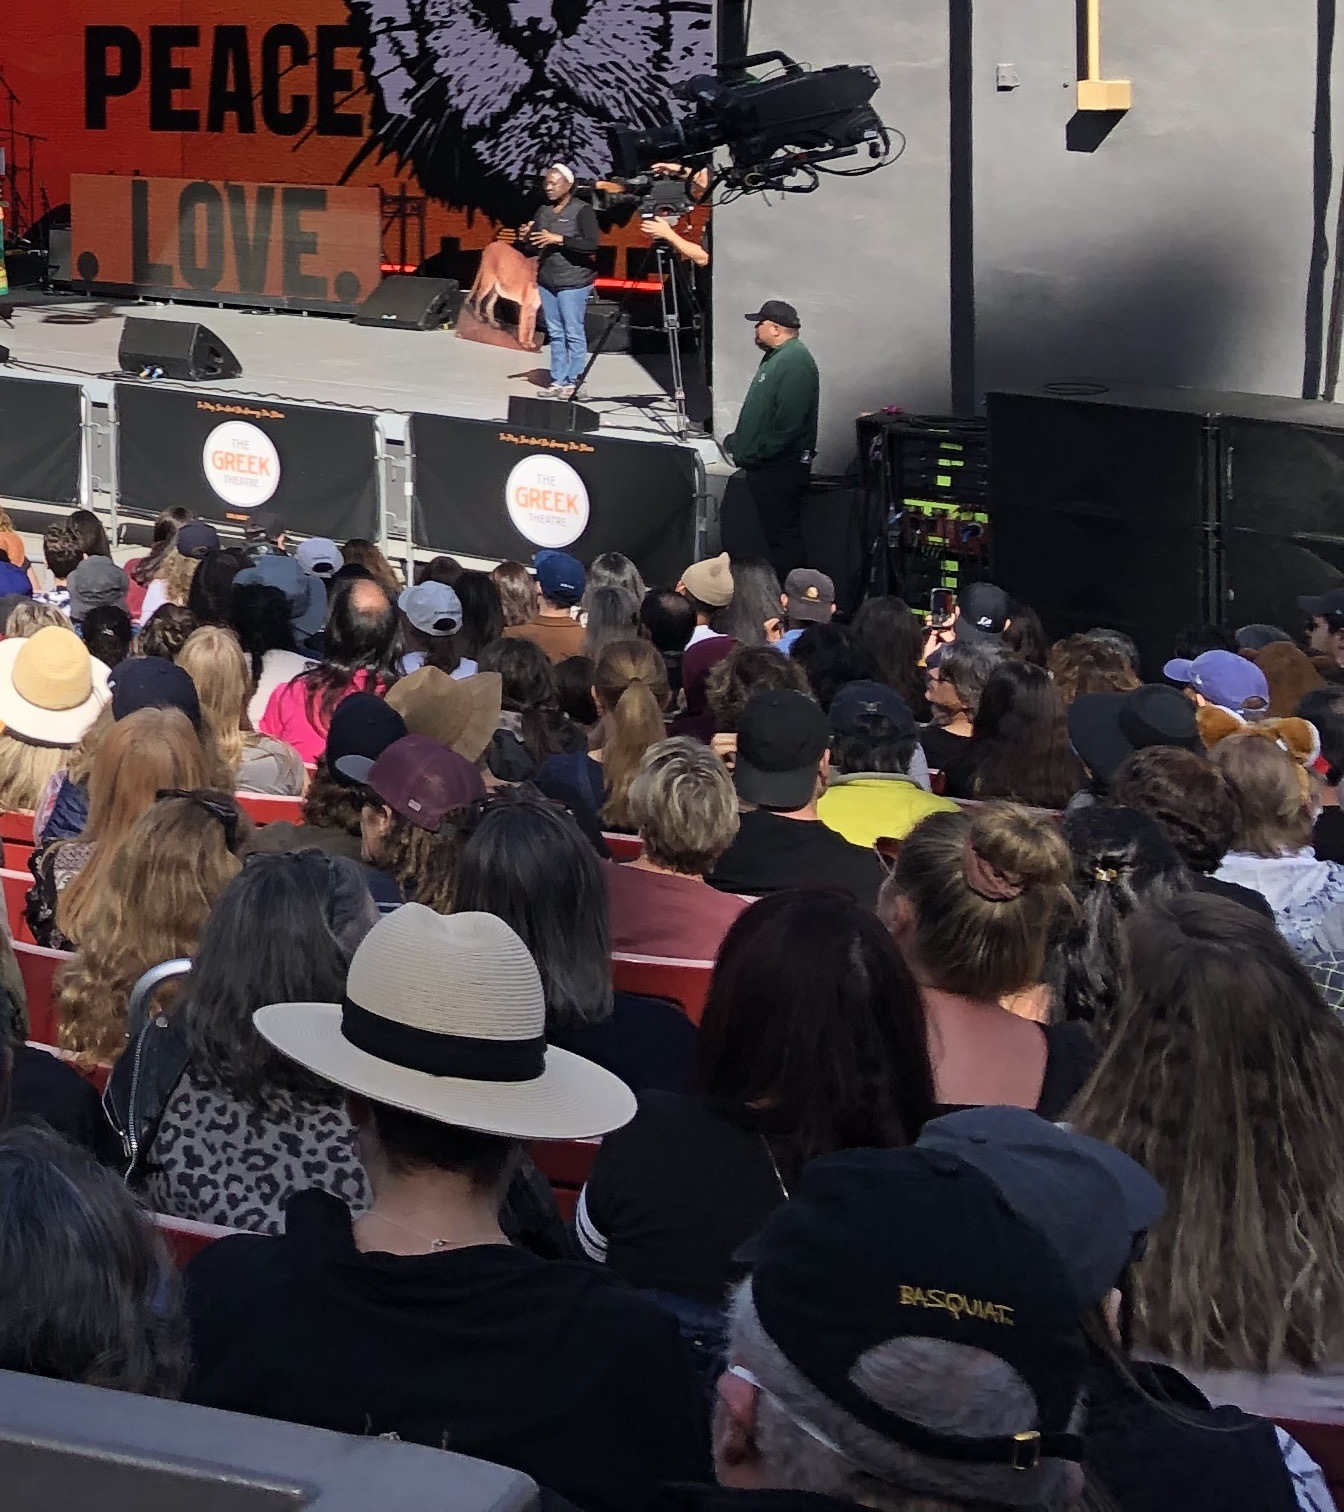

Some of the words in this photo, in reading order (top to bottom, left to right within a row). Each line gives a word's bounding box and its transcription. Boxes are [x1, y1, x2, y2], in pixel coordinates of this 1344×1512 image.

[84, 24, 361, 136] PEACE
[230, 438, 251, 451] THE
[211, 450, 271, 477] GREEK
[224, 474, 259, 488] THEATRE
[536, 472, 557, 486] THE
[515, 486, 579, 515] GREEK
[528, 512, 568, 528] THEATRE
